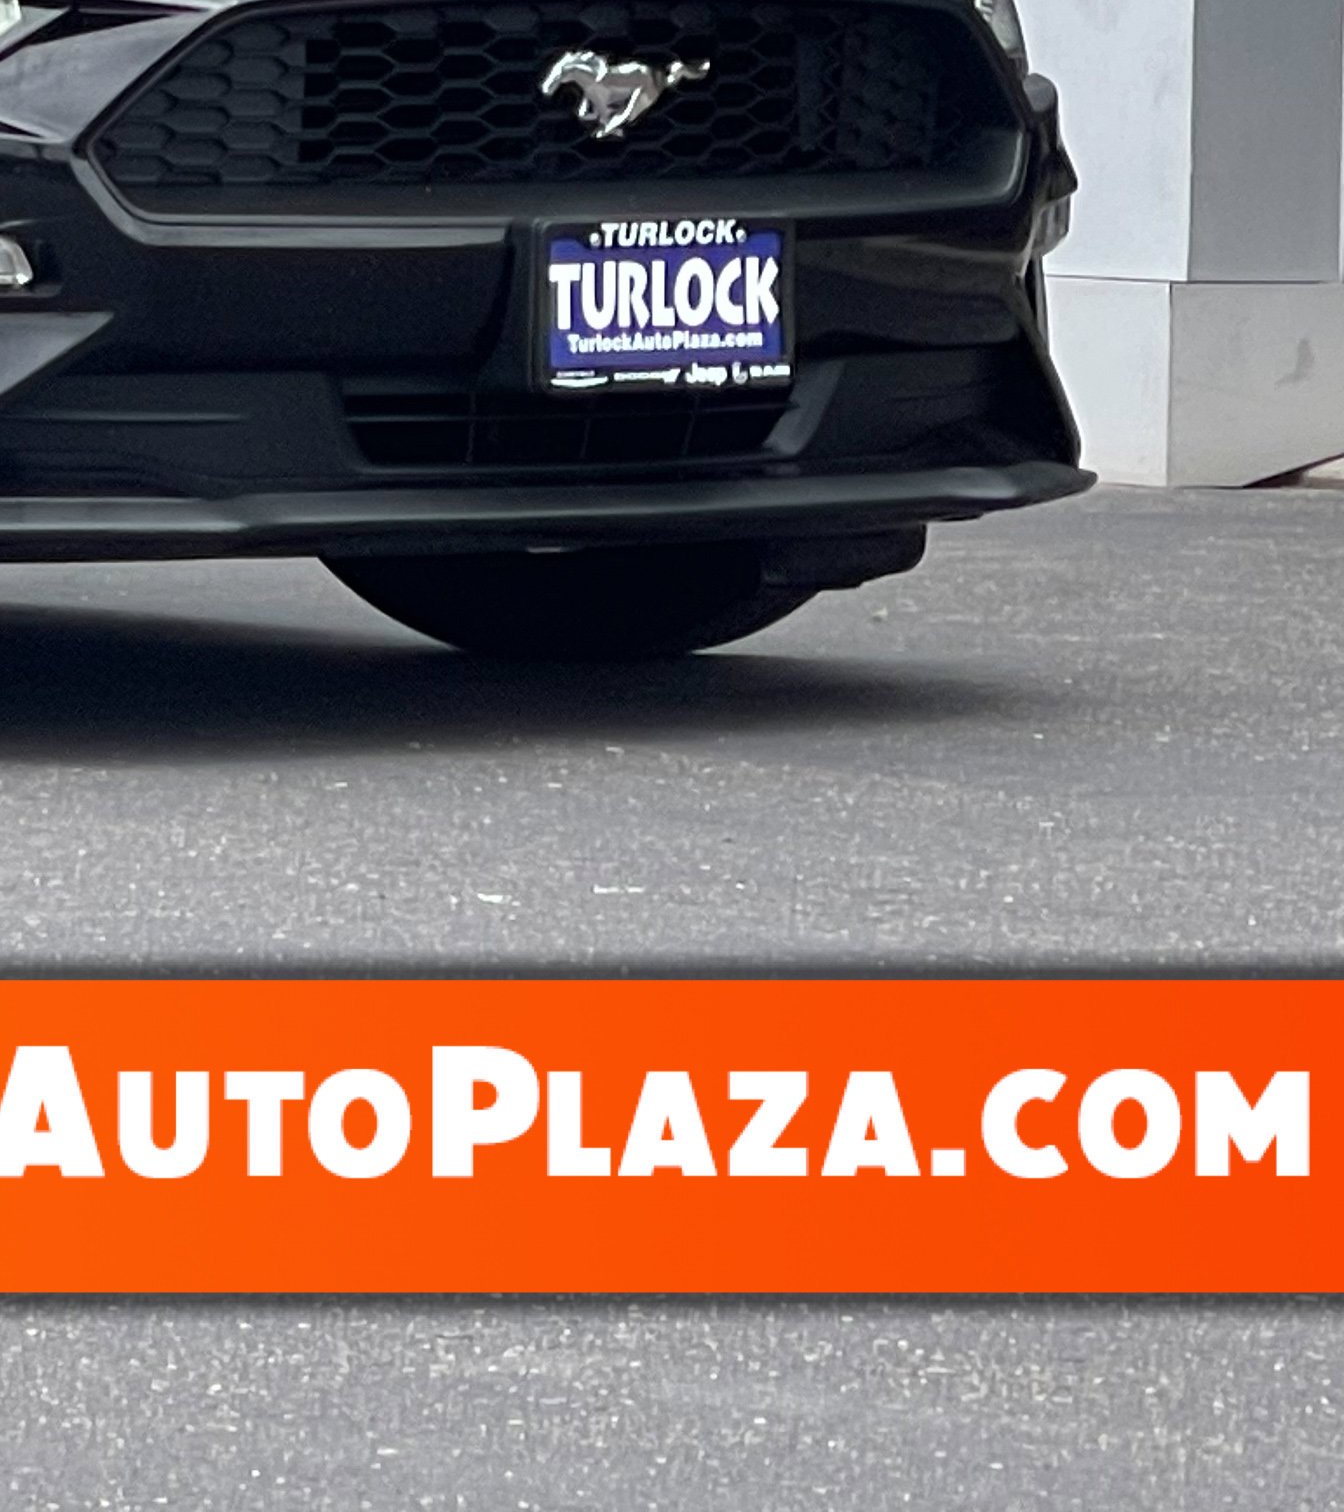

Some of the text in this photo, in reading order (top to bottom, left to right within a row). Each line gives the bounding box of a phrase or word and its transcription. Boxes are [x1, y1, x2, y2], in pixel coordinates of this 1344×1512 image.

[601, 219, 736, 247] TURLOCK
[549, 256, 779, 330] TURLOCK
[567, 330, 764, 354] TurlockAutoPlaza.com
